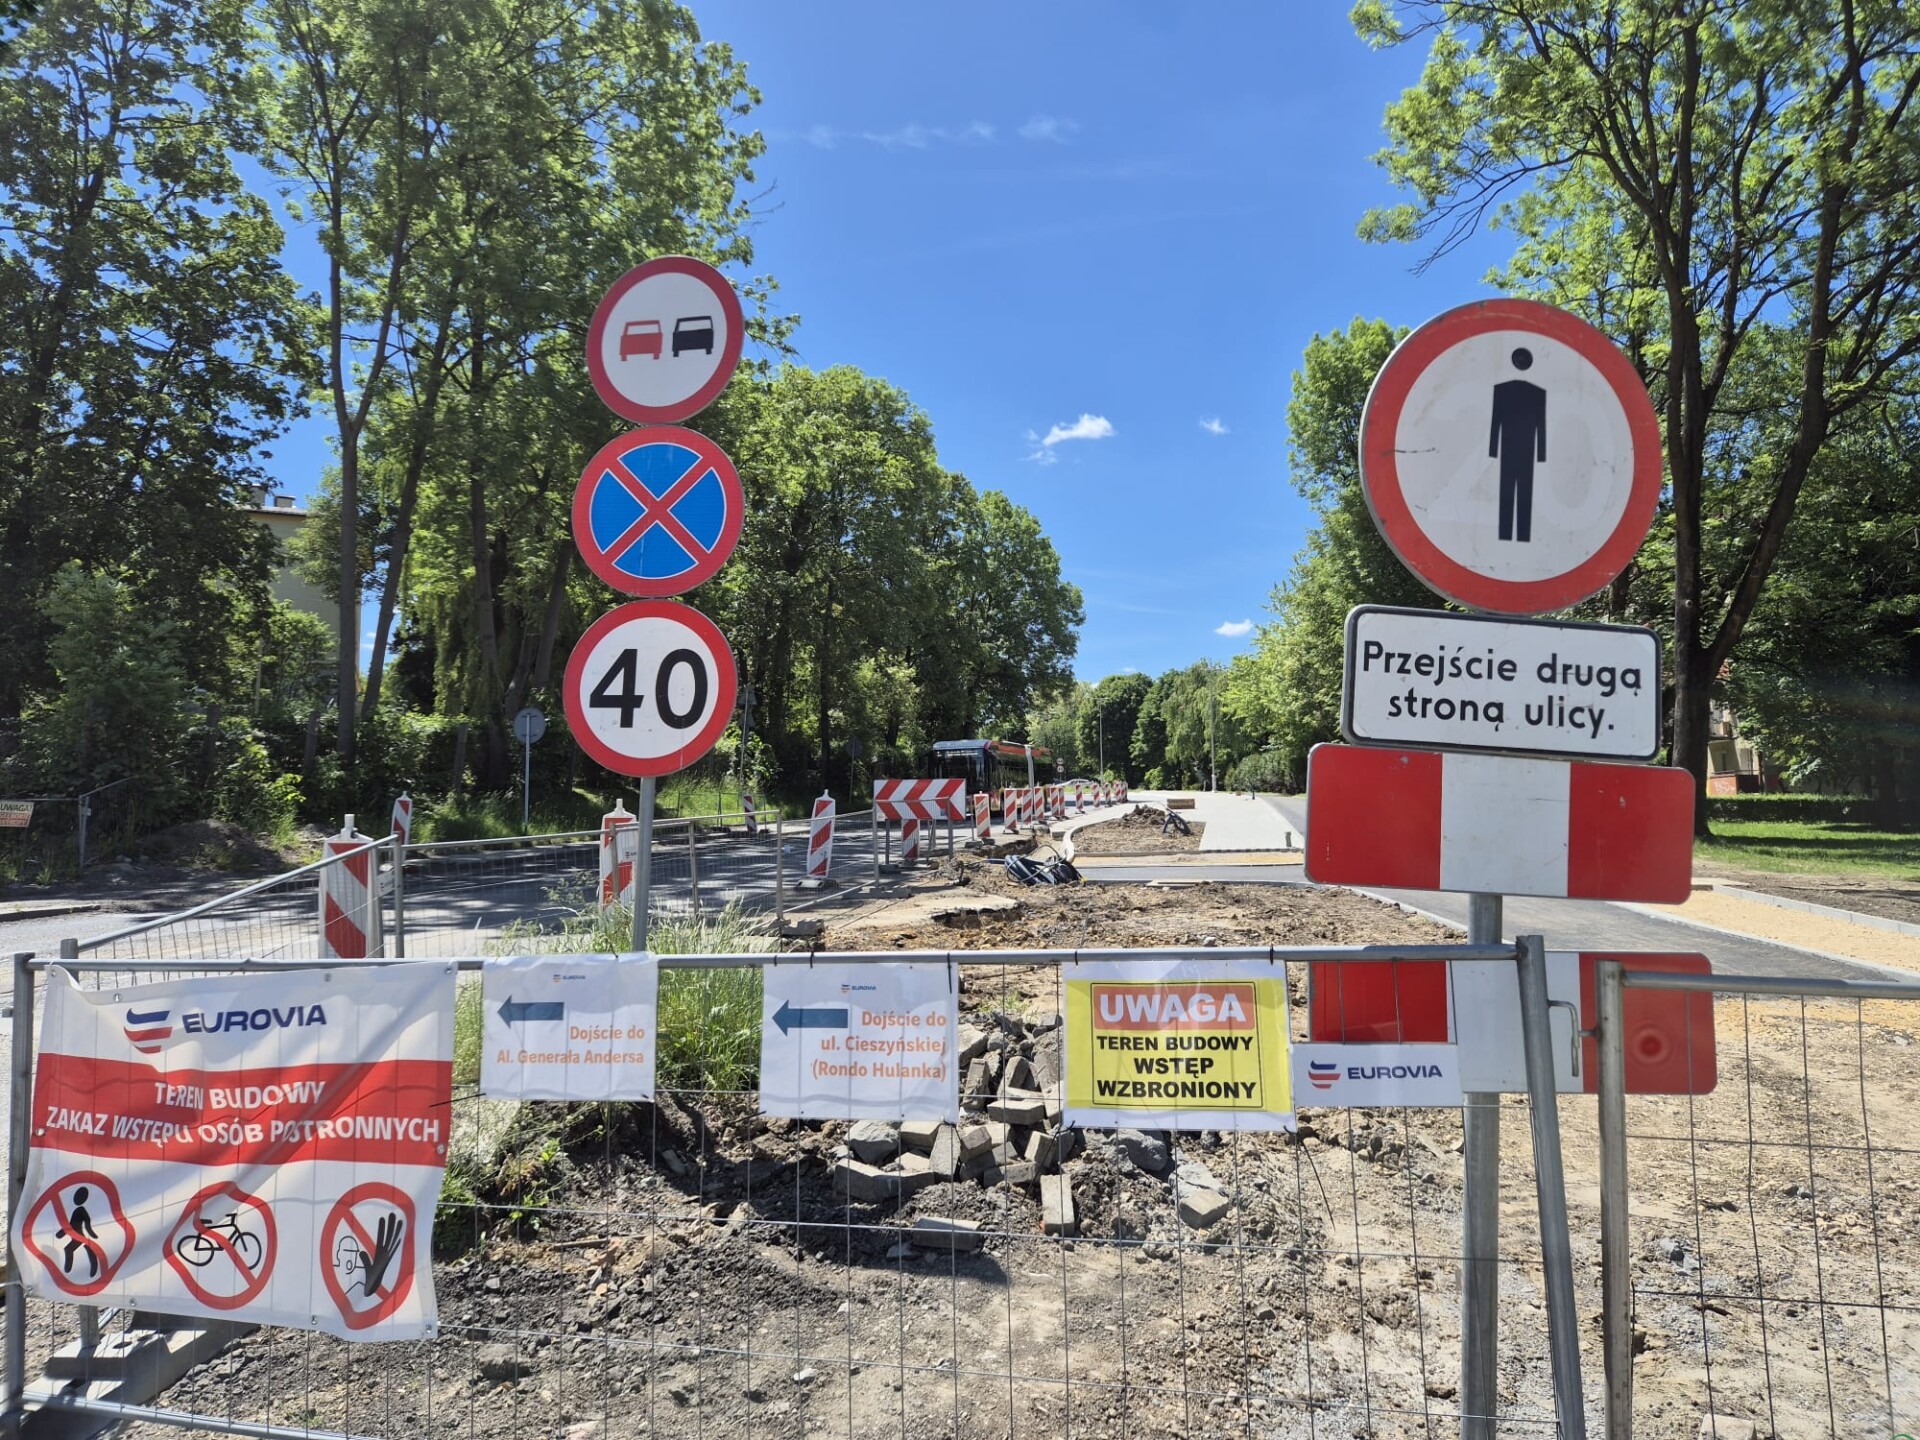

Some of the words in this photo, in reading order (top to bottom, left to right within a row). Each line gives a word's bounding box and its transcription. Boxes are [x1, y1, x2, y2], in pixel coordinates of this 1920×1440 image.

[1363, 640, 1518, 686] Przejście
[1536, 653, 1642, 697] drugą
[589, 648, 708, 730] 40
[1388, 687, 1505, 732] stroną
[1525, 696, 1615, 739] ulicy.
[182, 1004, 327, 1033] EUROVIA
[1100, 993, 1246, 1023] UWAGA
[861, 1011, 920, 1030] Dojście
[926, 1011, 947, 1026] do
[570, 1025, 622, 1043] Dojście
[627, 1025, 645, 1039] do
[1096, 1036, 1158, 1051] TEREN
[1166, 1036, 1253, 1051] BUDOWY
[497, 1050, 514, 1063] Al.
[518, 1050, 580, 1063] Generała
[584, 1050, 644, 1063] Andersa
[821, 1036, 840, 1051] ul.
[845, 1036, 947, 1056] Cieszyńskiej
[812, 1059, 868, 1080] (Rondo
[873, 1062, 947, 1081] Hulanka)
[1134, 1057, 1214, 1078] WSTĘP
[1347, 1065, 1443, 1080] EUROVIA
[155, 1081, 203, 1110] TEREN
[209, 1081, 326, 1110] BUDOWY
[1097, 1080, 1256, 1099] WZBRONIONY
[46, 1105, 107, 1135] ZAKAZ
[112, 1116, 192, 1148] WSTĘPU
[198, 1117, 264, 1145] OSÓB
[270, 1117, 440, 1143] POSTRONNYCH
